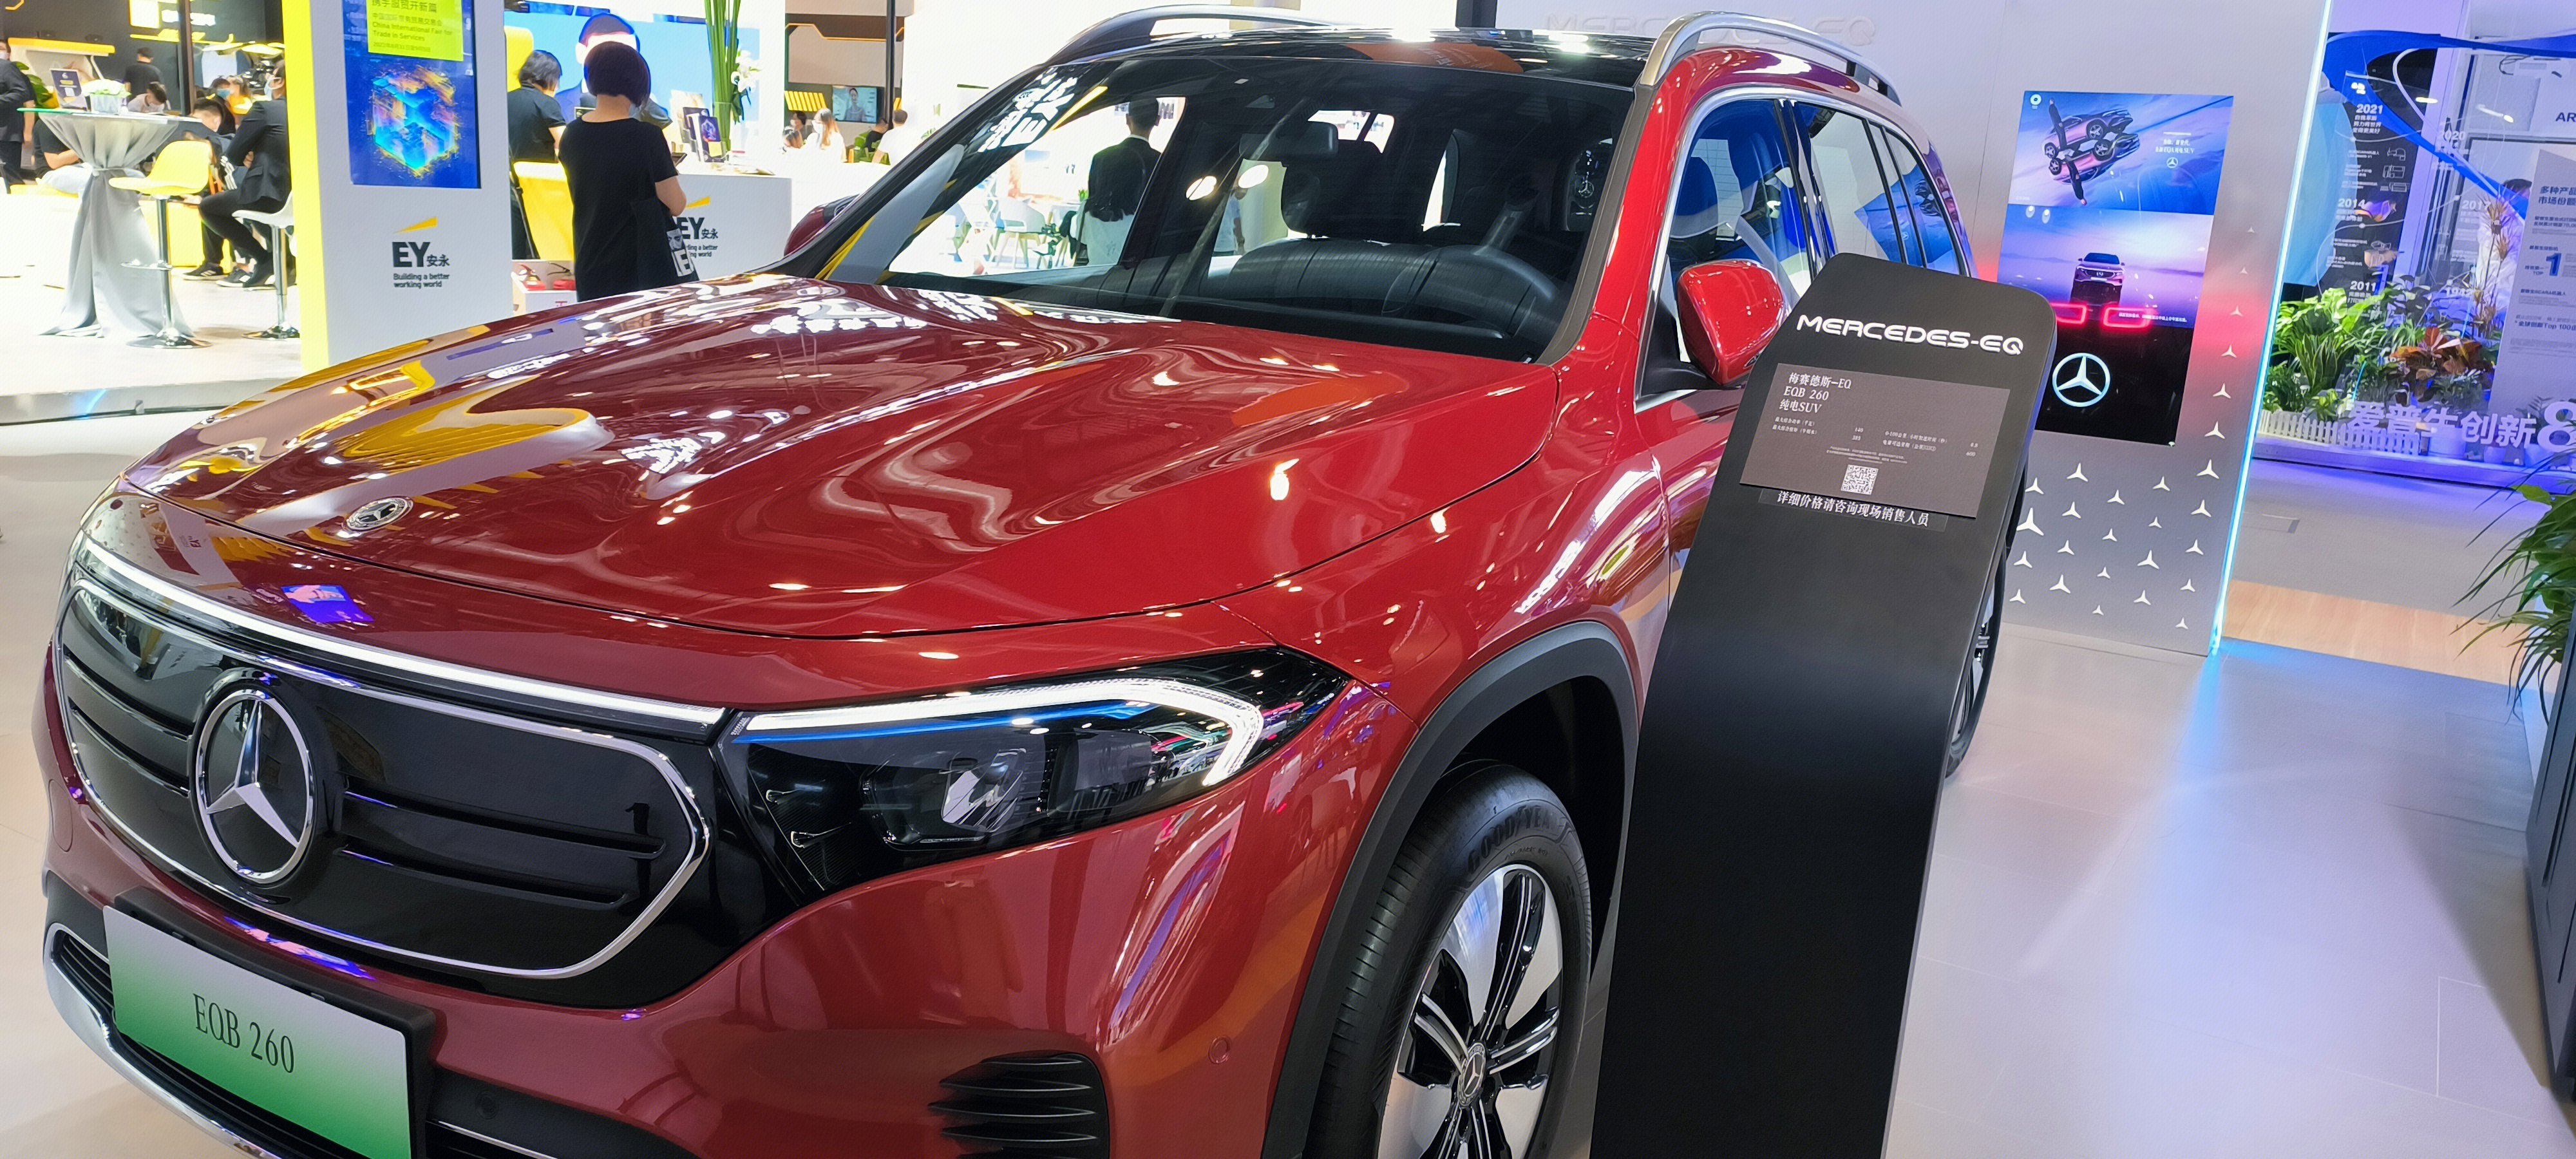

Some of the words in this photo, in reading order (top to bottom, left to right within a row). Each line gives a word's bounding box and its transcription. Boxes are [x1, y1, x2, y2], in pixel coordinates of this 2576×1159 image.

[2356, 104, 2383, 114] 2021
[677, 217, 705, 240] EY
[701, 229, 718, 239] 安永
[392, 241, 430, 267] EY
[426, 254, 450, 267] 安永
[2546, 253, 2562, 276] 1
[393, 273, 422, 281] Building
[393, 281, 422, 289] working
[2350, 281, 2376, 291] 2011
[1796, 314, 2024, 355] MERCEDES-EQ
[1783, 386, 1806, 398] EQB
[1809, 389, 1830, 401] 260
[1779, 399, 1822, 413] 纯电SUV
[1776, 490, 1929, 527] 详细价格请咨询现场销售人员
[193, 993, 240, 1049] EQB
[249, 1021, 294, 1073] 260
